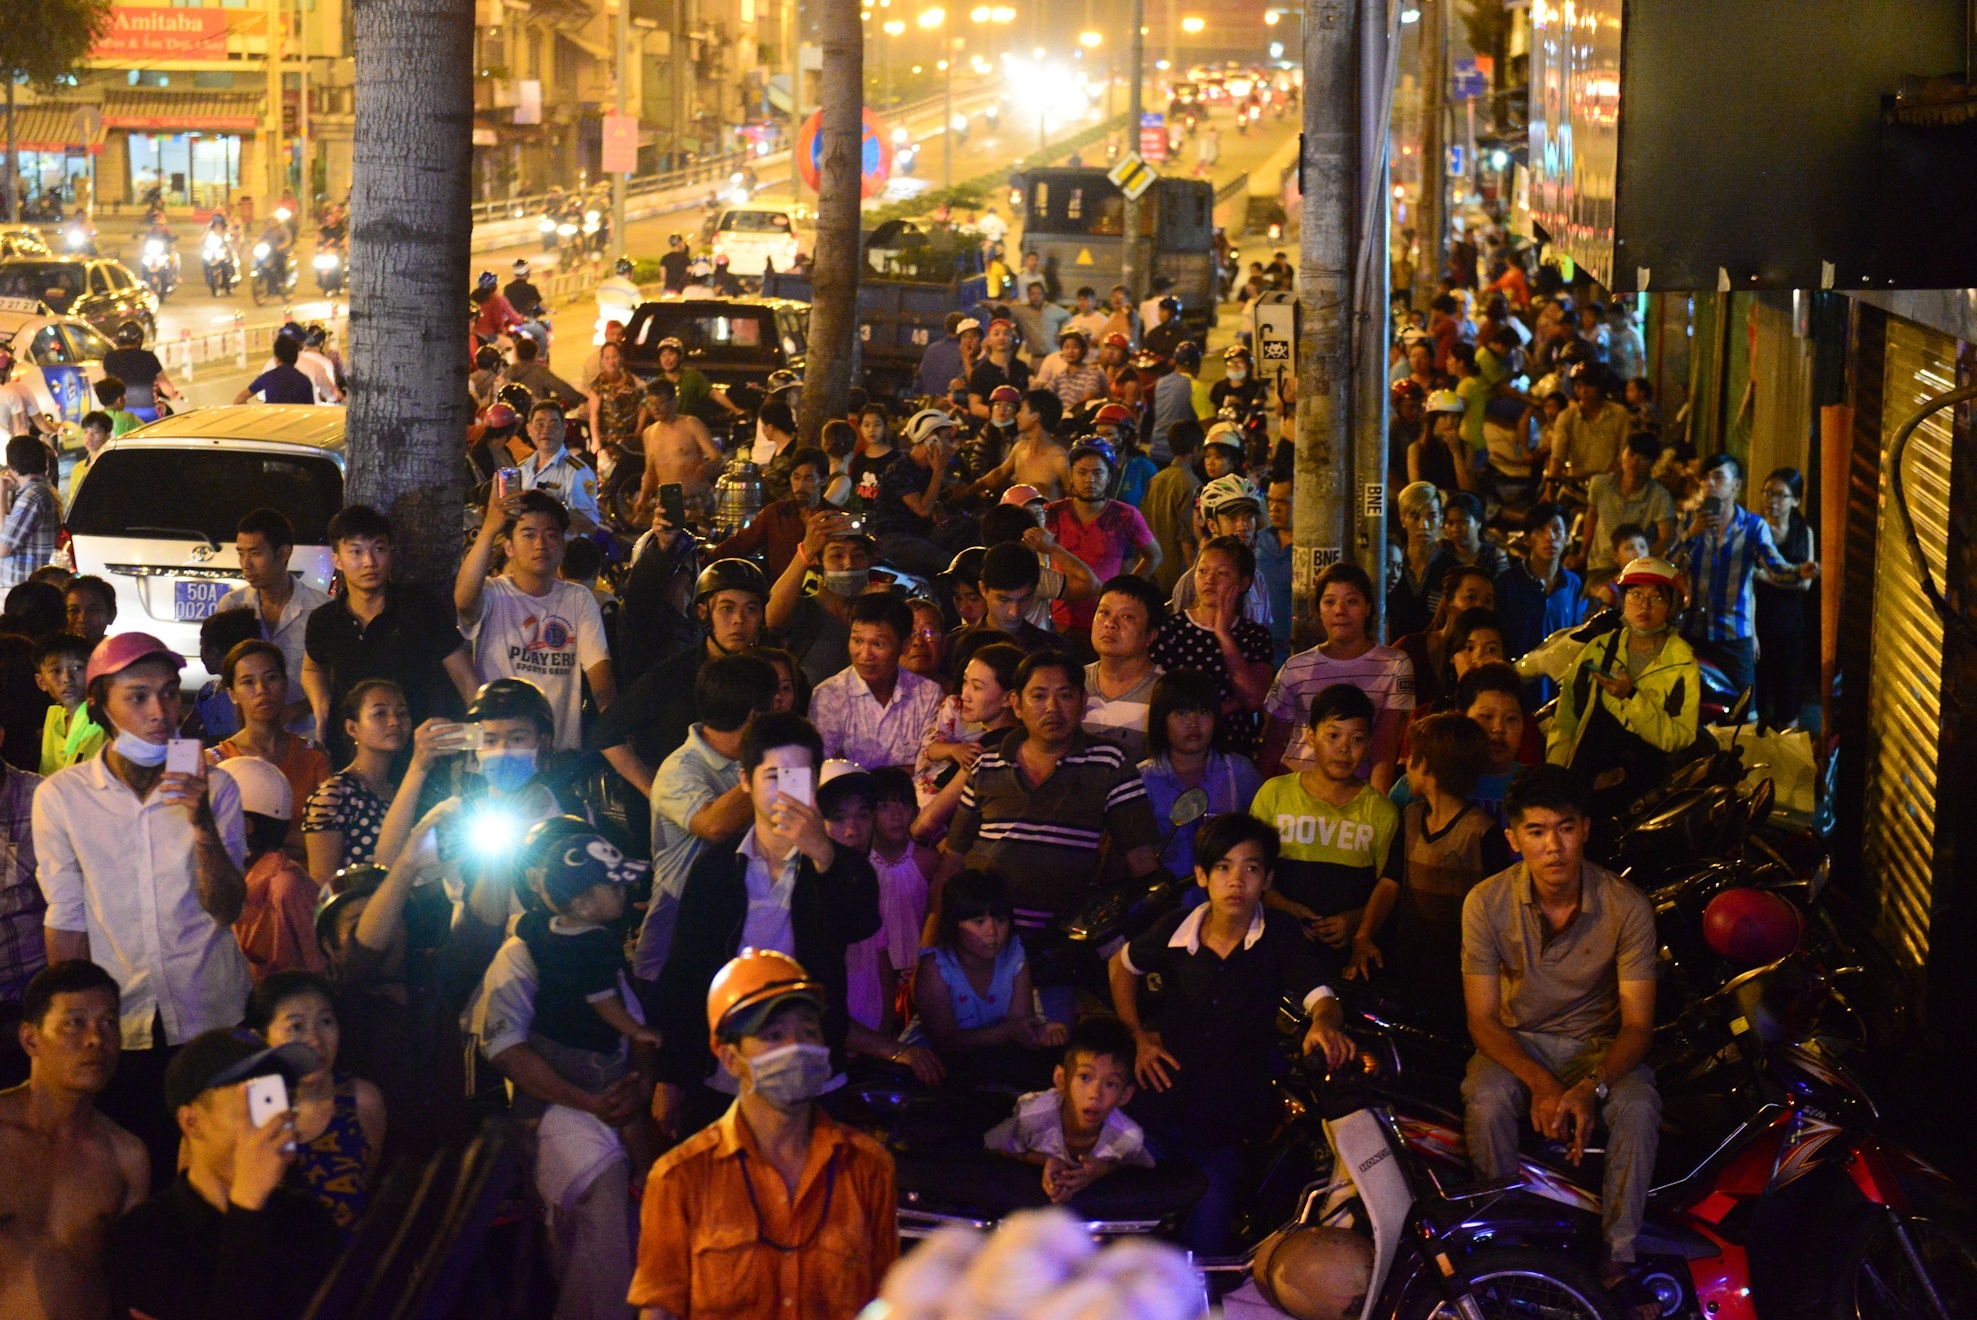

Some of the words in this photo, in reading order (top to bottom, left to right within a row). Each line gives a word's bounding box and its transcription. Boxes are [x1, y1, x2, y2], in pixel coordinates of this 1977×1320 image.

[113, 12, 203, 31] Amitaba
[1367, 486, 1382, 514] BNE
[187, 583, 217, 601] 50A
[517, 662, 547, 675] SPORTS
[1277, 814, 1375, 851] DOVER
[1802, 1105, 1827, 1120] SYM
